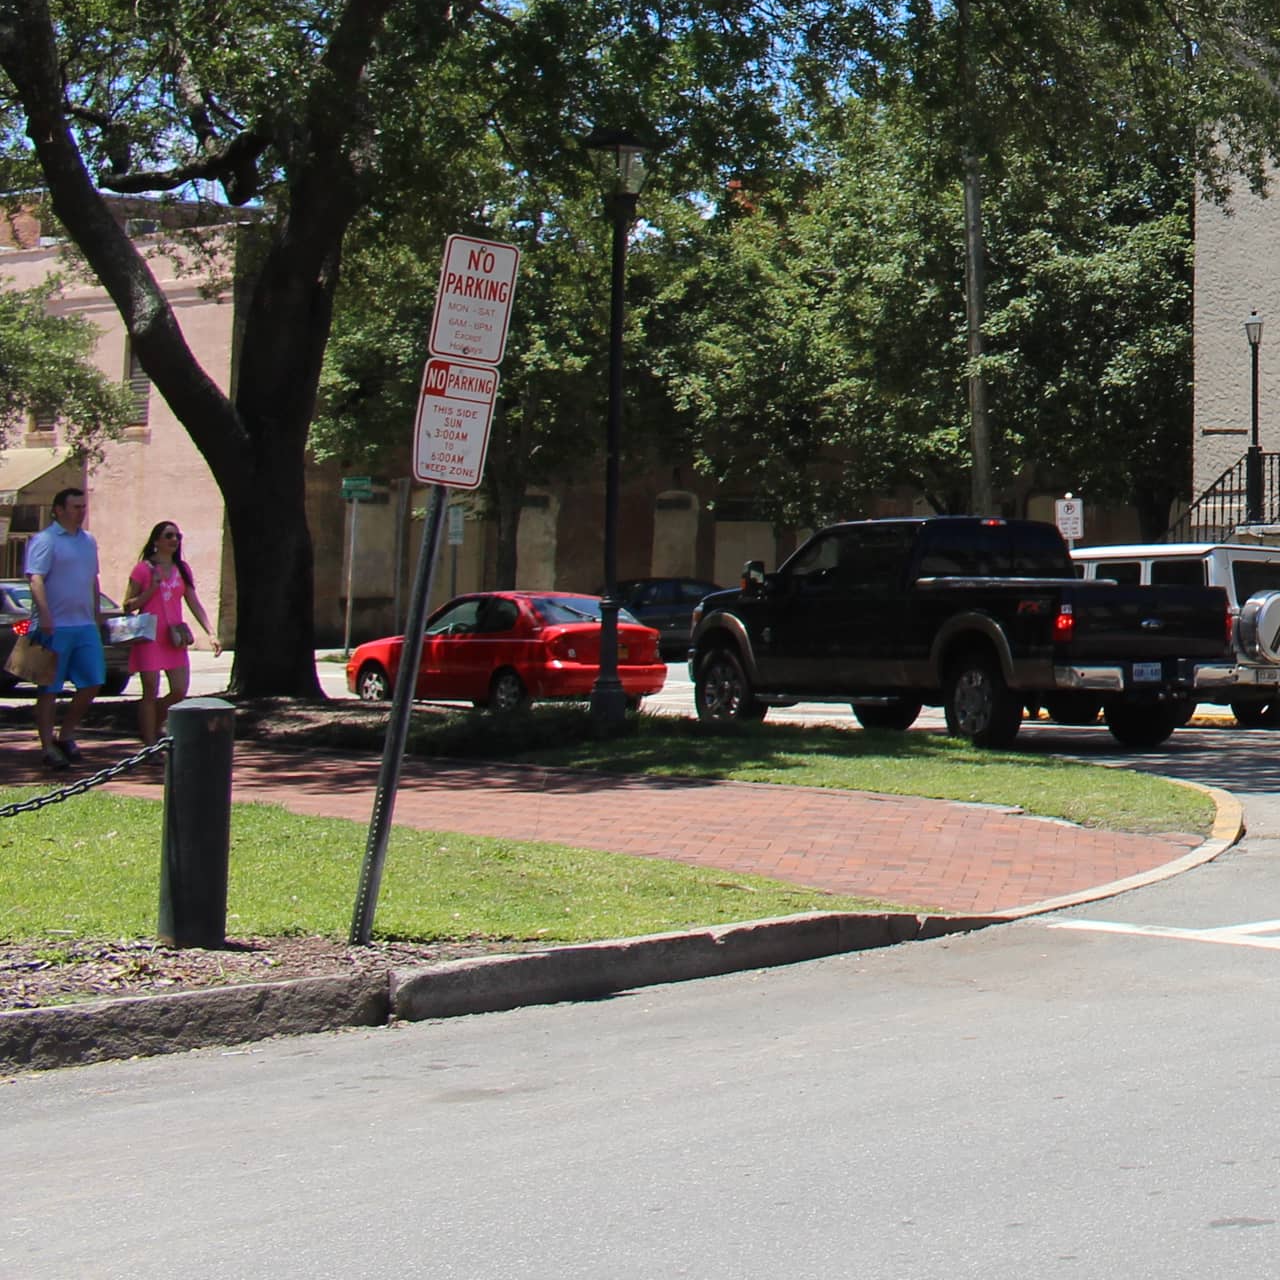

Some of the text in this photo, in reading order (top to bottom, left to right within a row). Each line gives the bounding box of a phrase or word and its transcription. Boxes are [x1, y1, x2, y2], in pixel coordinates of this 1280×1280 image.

[467, 249, 496, 274] NO
[446, 273, 509, 303] PARKING
[448, 302, 469, 313] MON
[478, 307, 496, 317] SAT
[449, 341, 484, 355] Holays
[427, 368, 493, 395] NO PARKING
[433, 404, 479, 419] THIS SIDE
[443, 417, 463, 428] SUN
[434, 428, 468, 441] 3:00AM
[445, 441, 454, 451] TO
[431, 452, 464, 464] 6:00AM
[421, 461, 475, 478] WEEP ZONE
